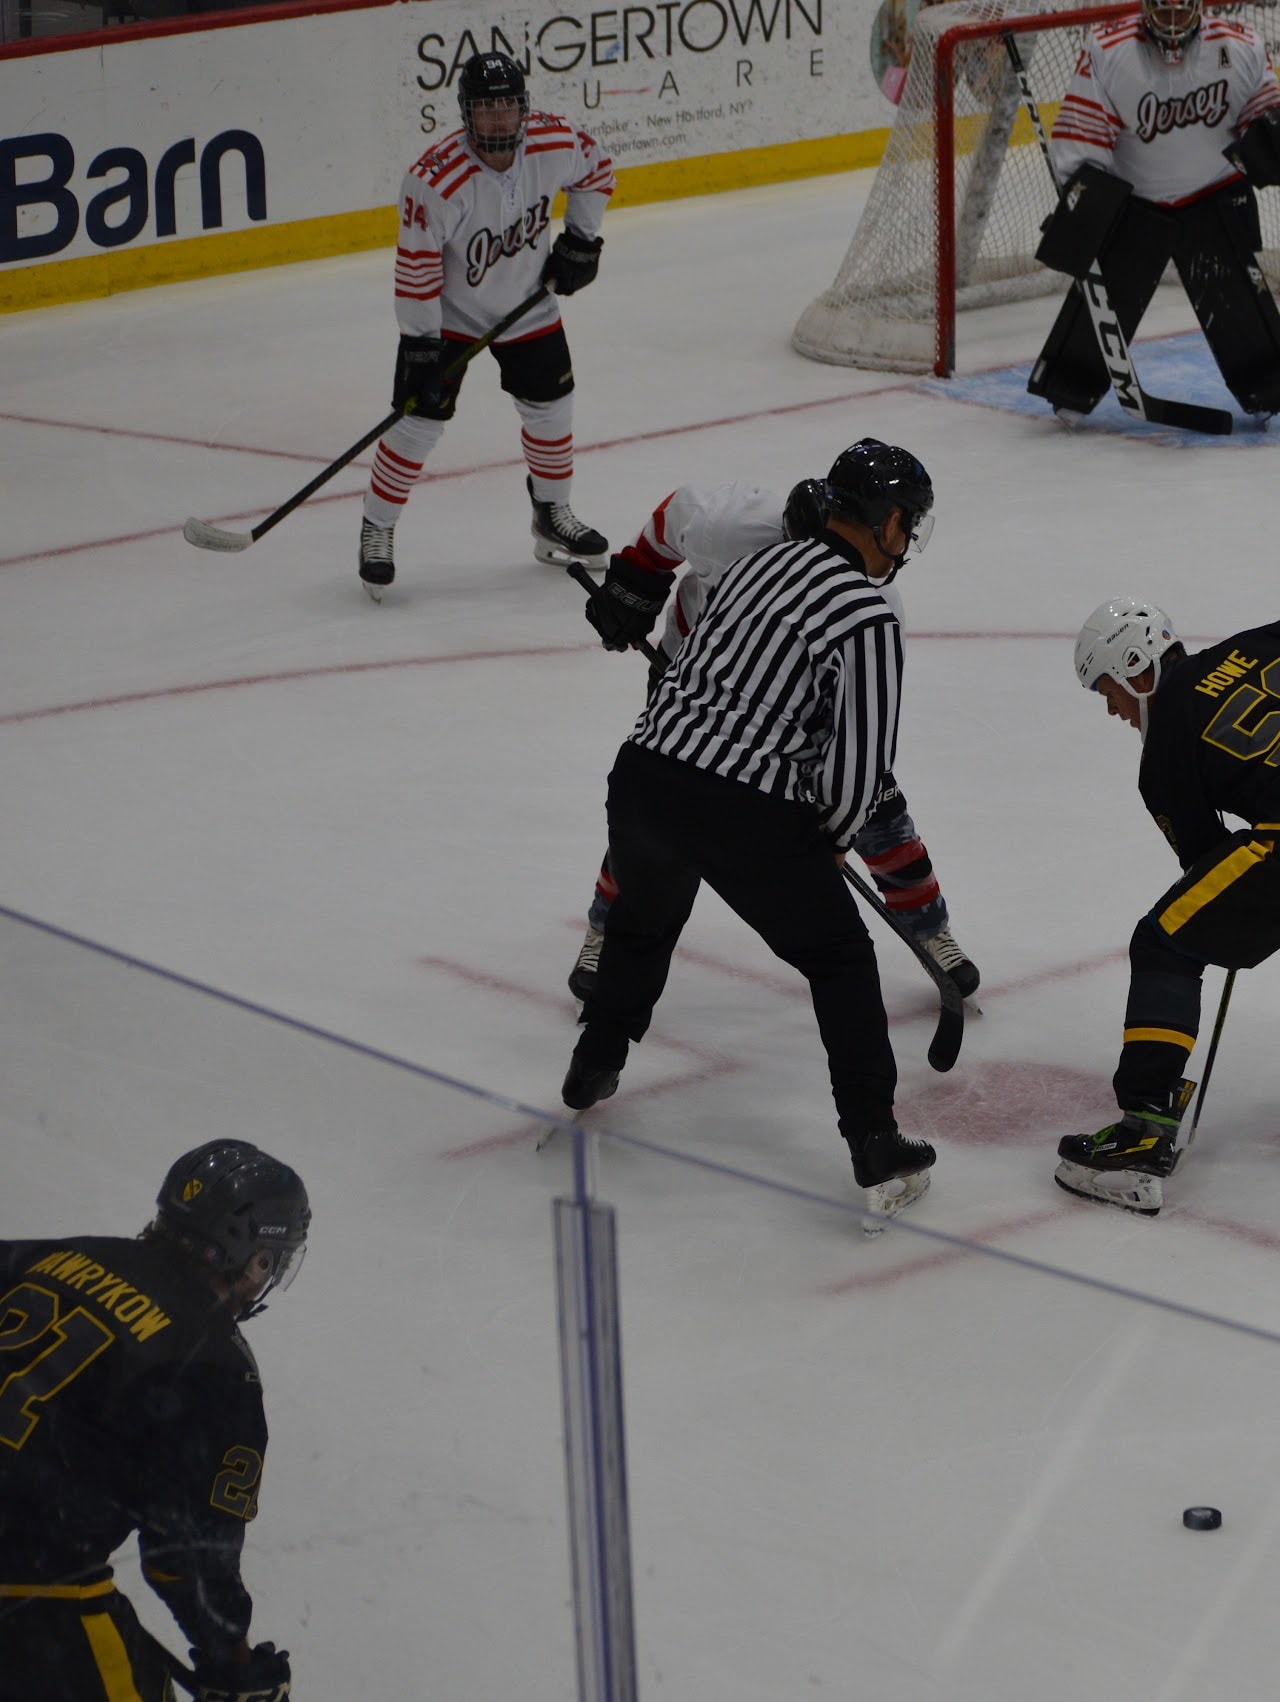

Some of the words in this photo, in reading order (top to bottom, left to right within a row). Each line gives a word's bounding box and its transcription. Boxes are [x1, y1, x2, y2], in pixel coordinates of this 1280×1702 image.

[416, 0, 823, 91] SANGERTOWN
[1218, 45, 1231, 68] A
[420, 48, 823, 134] SUARE
[647, 113, 672, 129] New
[1136, 79, 1229, 144] Jersey
[0, 128, 268, 264] Barn
[466, 194, 550, 288] Jersey
[1194, 649, 1259, 698] HOWE
[259, 1225, 288, 1235] CCM
[25, 1250, 172, 1344] AWRYKOW
[210, 1444, 264, 1523] 2
